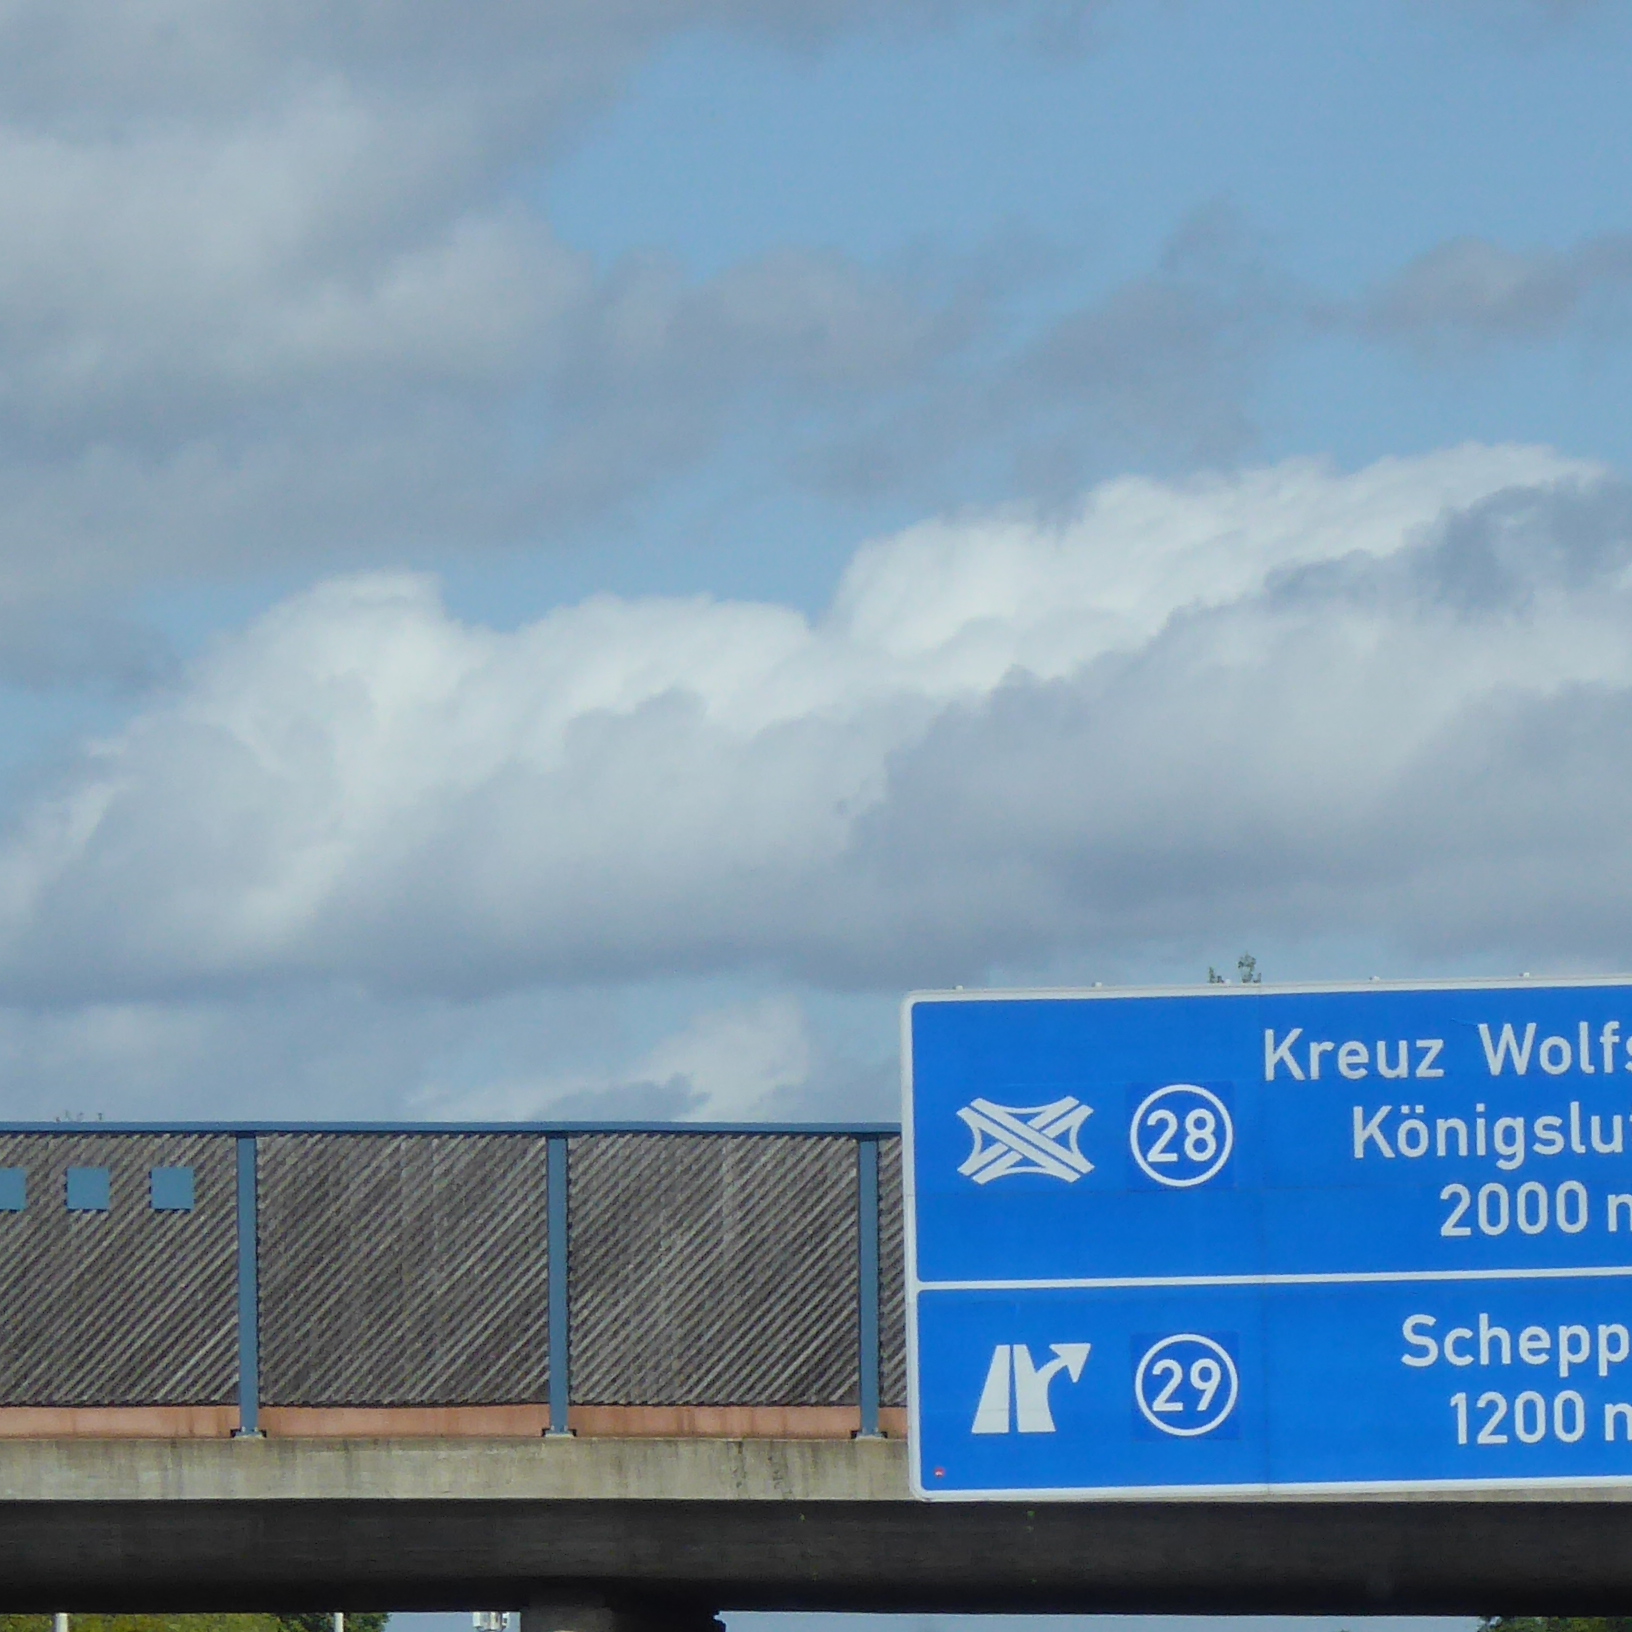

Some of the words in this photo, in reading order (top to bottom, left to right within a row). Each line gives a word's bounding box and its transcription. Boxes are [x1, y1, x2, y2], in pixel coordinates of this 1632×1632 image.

[1264, 1028, 1444, 1081] Kreuz
[1145, 1109, 1217, 1163] 28
[1440, 1180, 1589, 1237] 2000
[1151, 1359, 1222, 1413] 29
[1450, 1389, 1586, 1445] 1200
